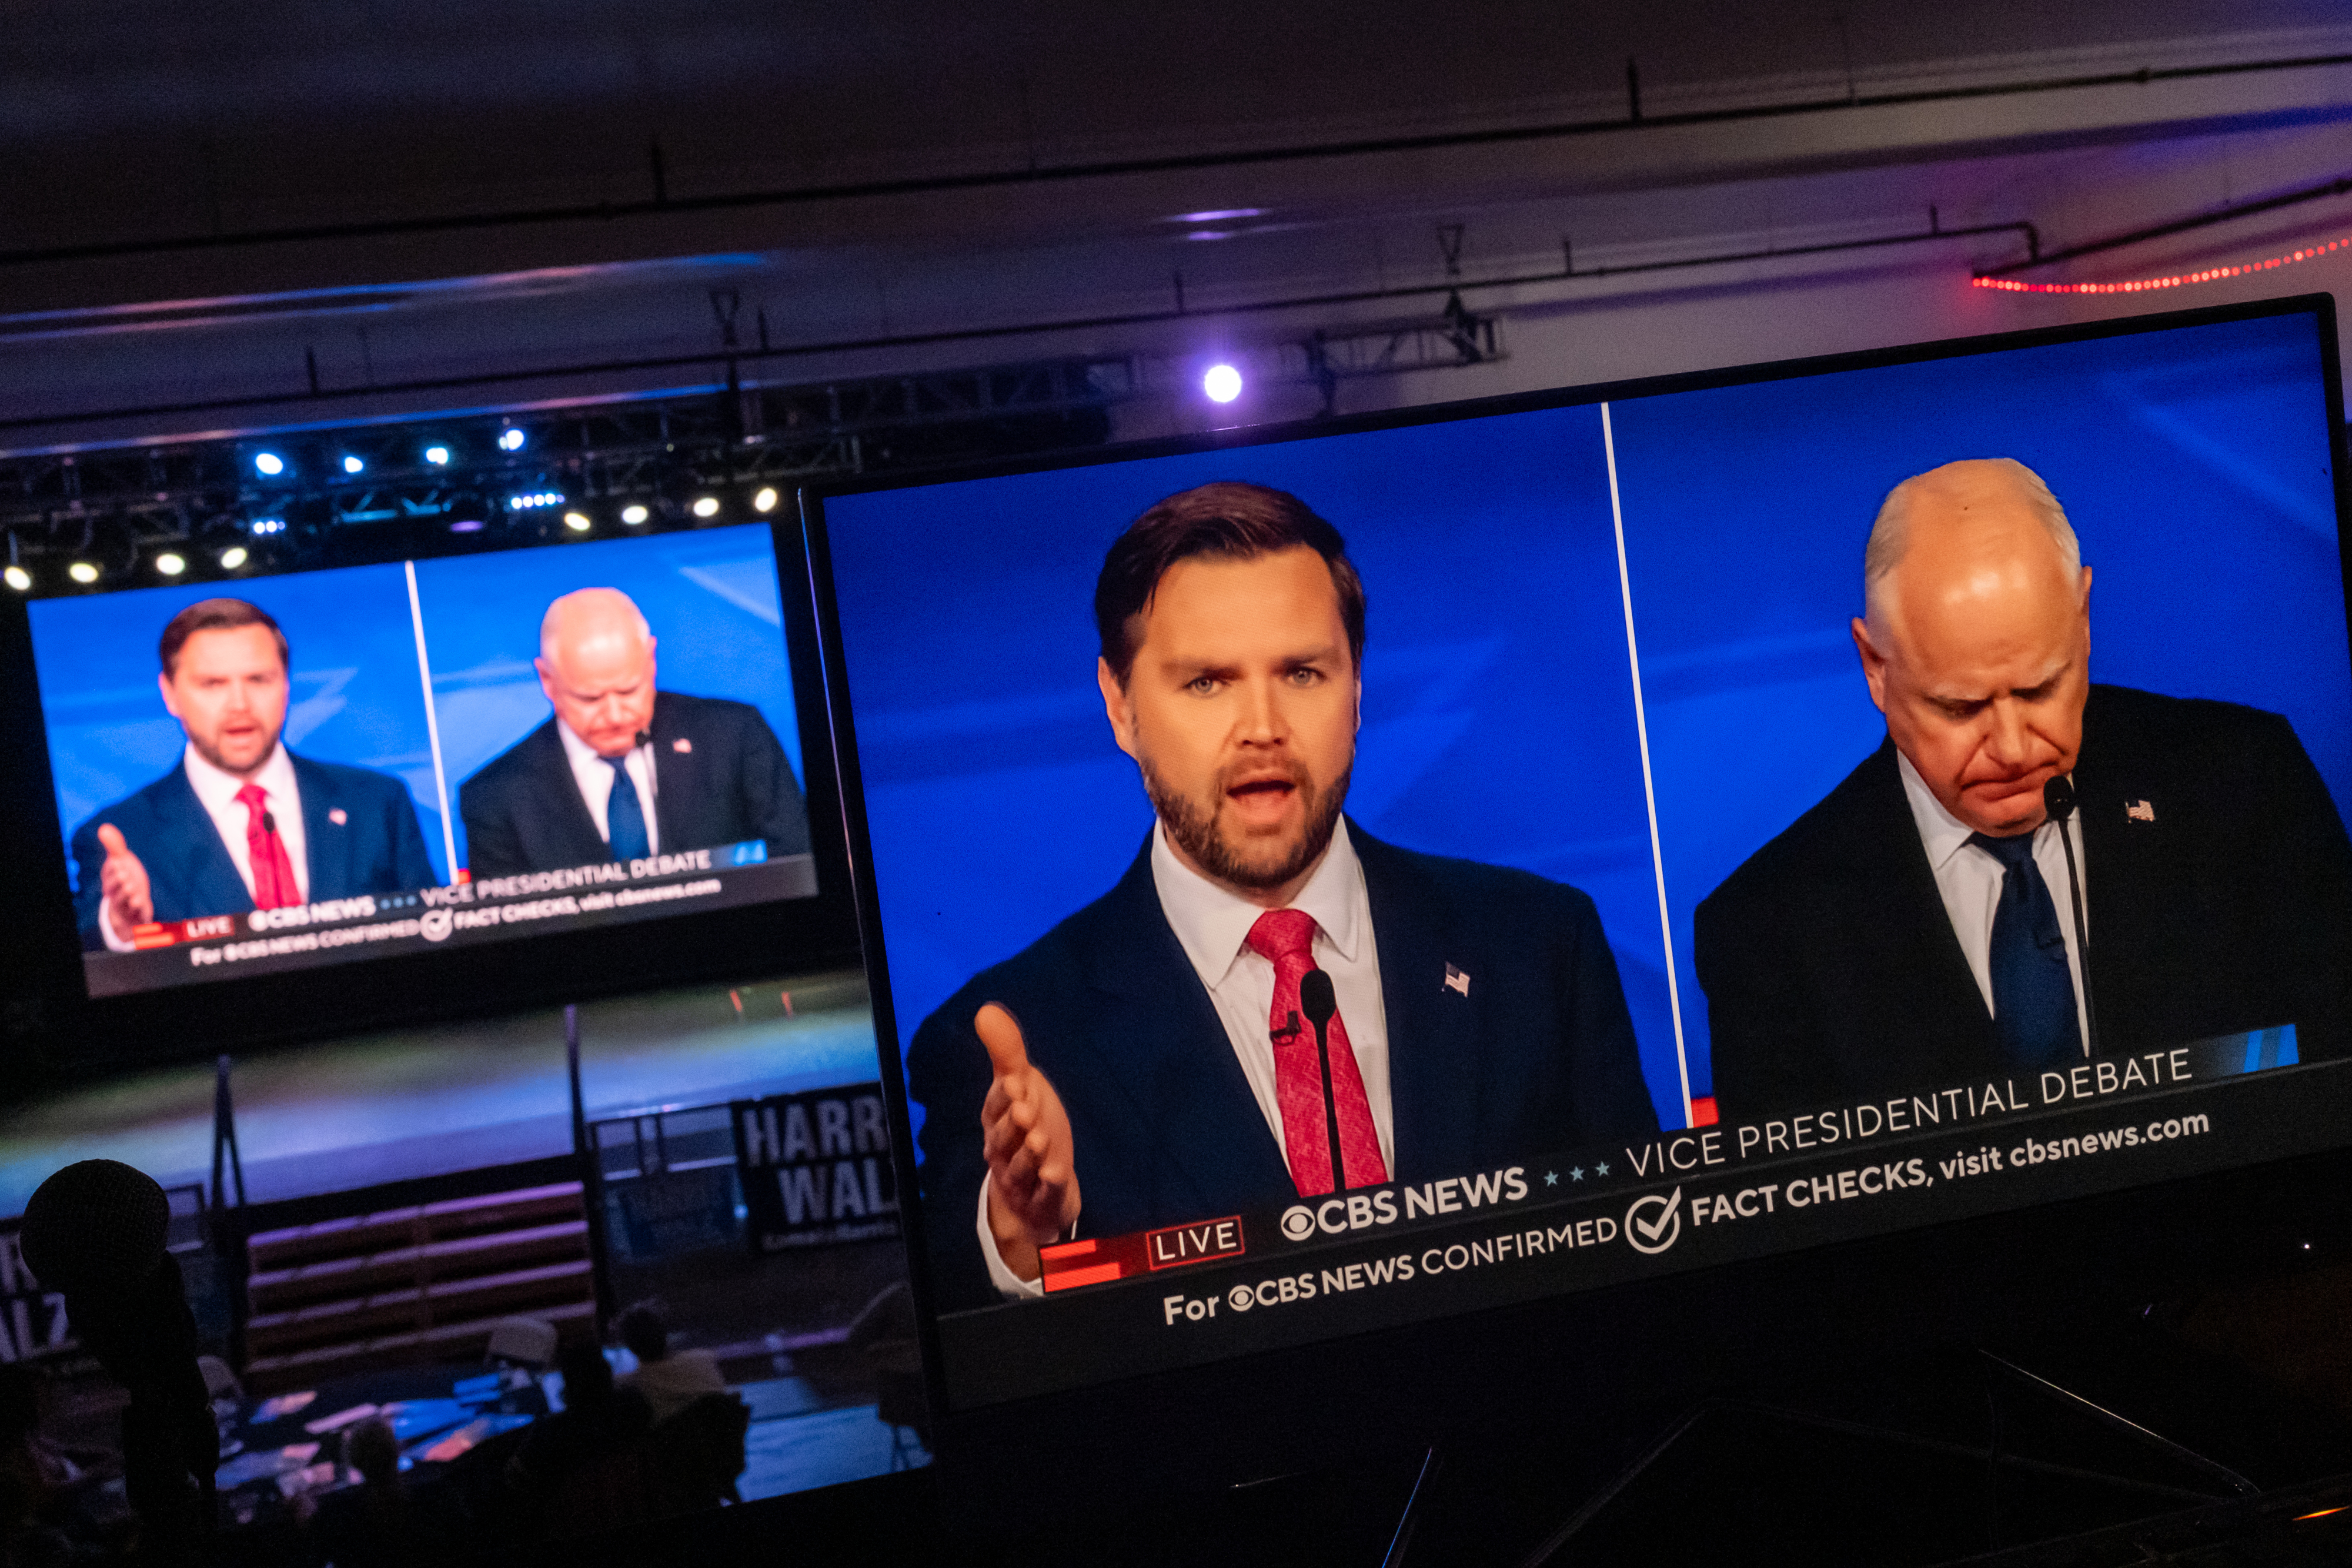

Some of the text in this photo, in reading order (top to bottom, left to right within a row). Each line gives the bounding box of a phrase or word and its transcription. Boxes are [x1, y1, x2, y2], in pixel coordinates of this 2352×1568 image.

[186, 916, 231, 938] LIVE
[191, 947, 222, 966] For
[453, 905, 502, 930] FACT
[502, 896, 580, 922] CHECKS,
[579, 892, 615, 911] visit
[615, 878, 722, 907] cbsnews.com
[267, 849, 712, 928] CBS NEWS VICE PRESIDENTIAL DEBATE
[1317, 1048, 2193, 1234] CBS NEWS VICE PRESIDENTIAL DEBATE
[1156, 1222, 1237, 1261] LIVE
[1164, 1114, 2210, 1325] For CBS NEWS CONFIRMED FACT CHECKS, visit cbsnews.com
